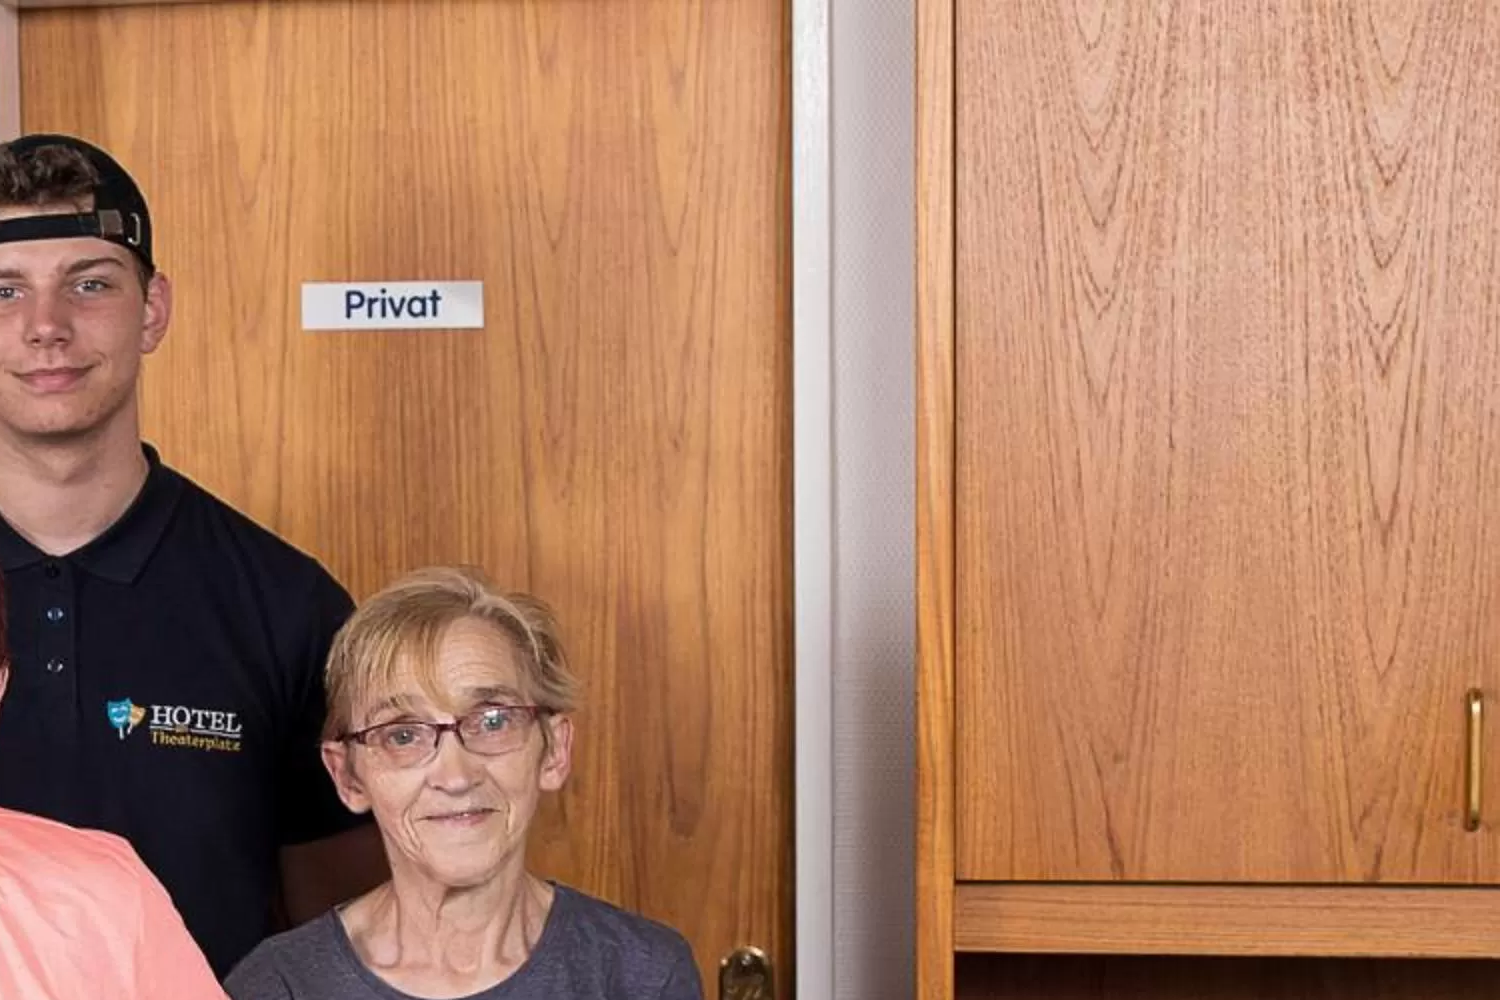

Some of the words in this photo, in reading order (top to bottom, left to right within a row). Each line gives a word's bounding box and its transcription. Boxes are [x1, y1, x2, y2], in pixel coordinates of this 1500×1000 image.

[345, 288, 442, 319] Privat
[151, 705, 242, 733] HOTEL
[151, 731, 241, 752] Theaterplatz
